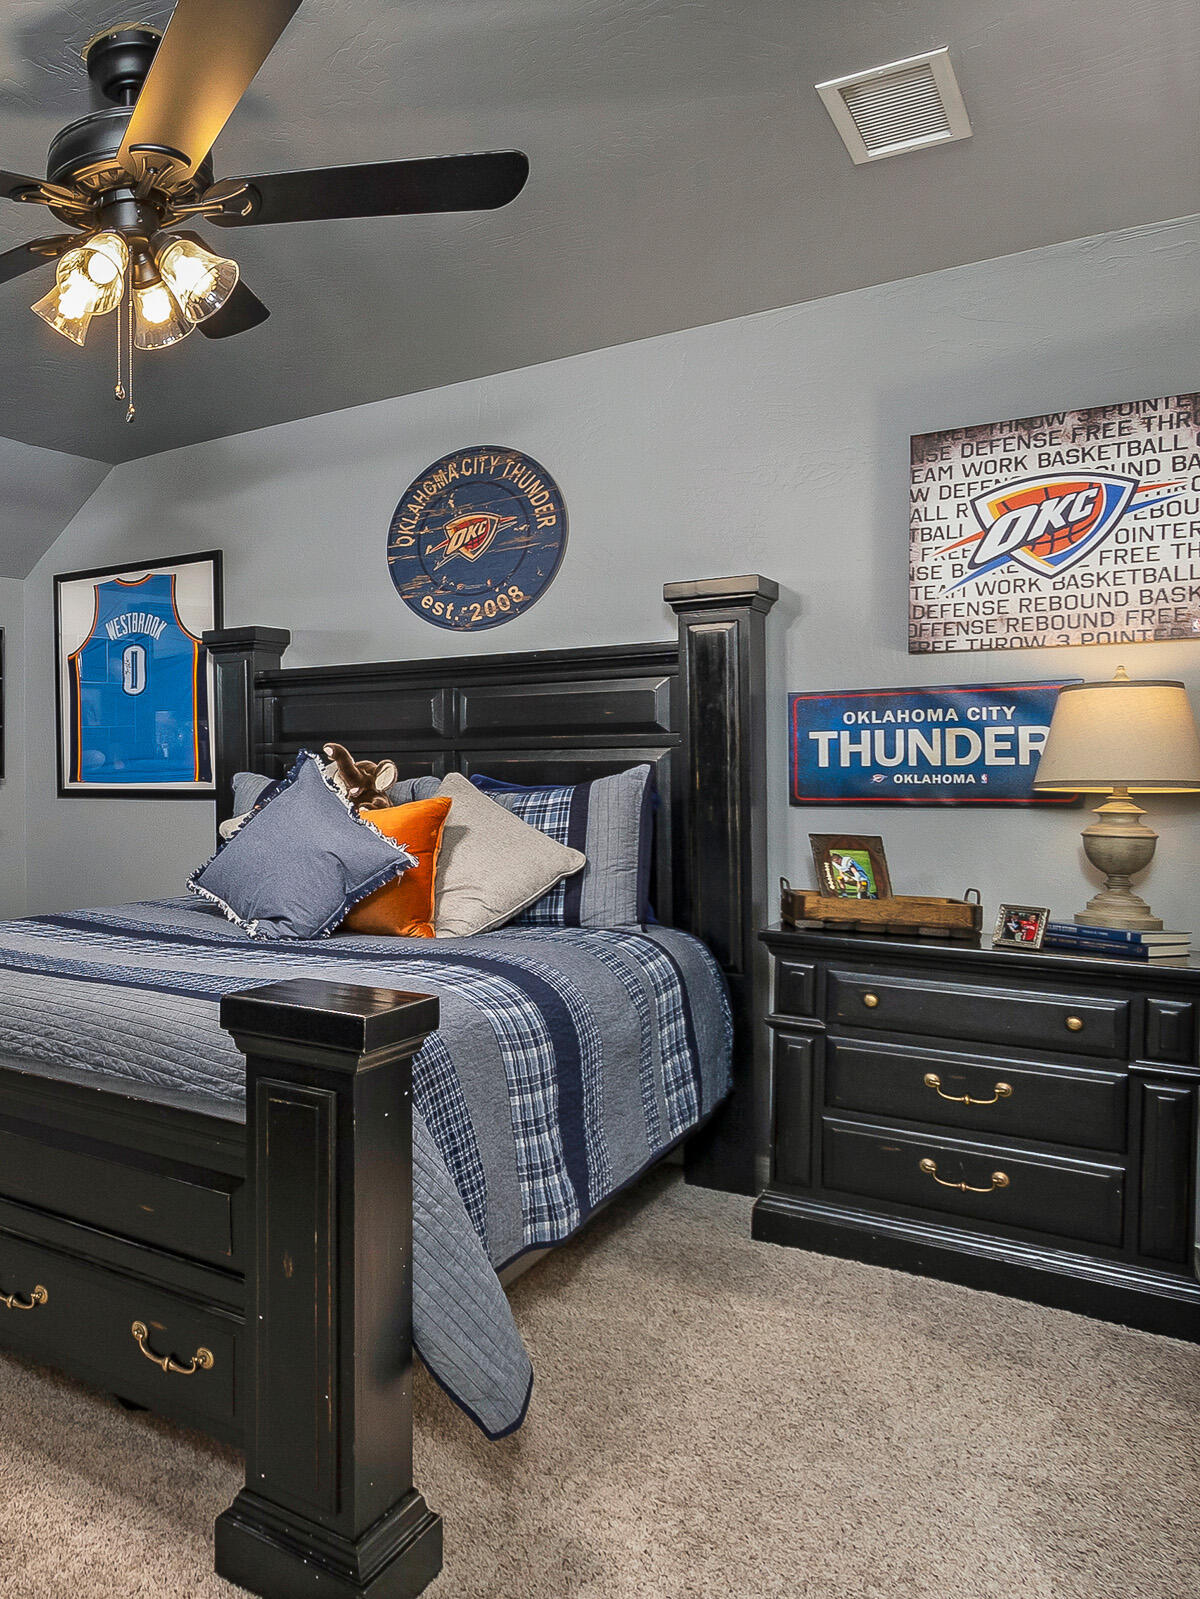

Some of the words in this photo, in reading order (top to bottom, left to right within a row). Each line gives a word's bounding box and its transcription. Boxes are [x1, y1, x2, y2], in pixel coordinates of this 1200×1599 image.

[960, 429, 1063, 459] DEFENSE
[1071, 419, 1134, 444] FREE
[961, 455, 1028, 479] WORK
[1038, 434, 1189, 469] BASKETBALL
[396, 463, 460, 547] OKLAHOMA
[461, 456, 501, 477] CITY
[502, 459, 557, 530] THUNDER
[446, 519, 489, 555] OKC
[970, 485, 1102, 569] OKC
[1099, 545, 1161, 566] FREE
[975, 577, 1042, 597] WORK
[1052, 563, 1200, 591] BASKETBALL
[421, 595, 460, 621] est.
[469, 585, 525, 622] 2008
[912, 599, 1010, 620] DEFENSE
[1019, 590, 1129, 614] REBOUND
[1006, 611, 1115, 634] REBOUND
[1125, 606, 1189, 627] FREE
[105, 612, 168, 641] WESTBROOK
[122, 644, 148, 697] 0
[843, 708, 959, 725] OKLAHOMA
[966, 706, 1016, 722] CITY
[809, 725, 1051, 768] THUNDER
[893, 774, 976, 785] OKLAHOMA
